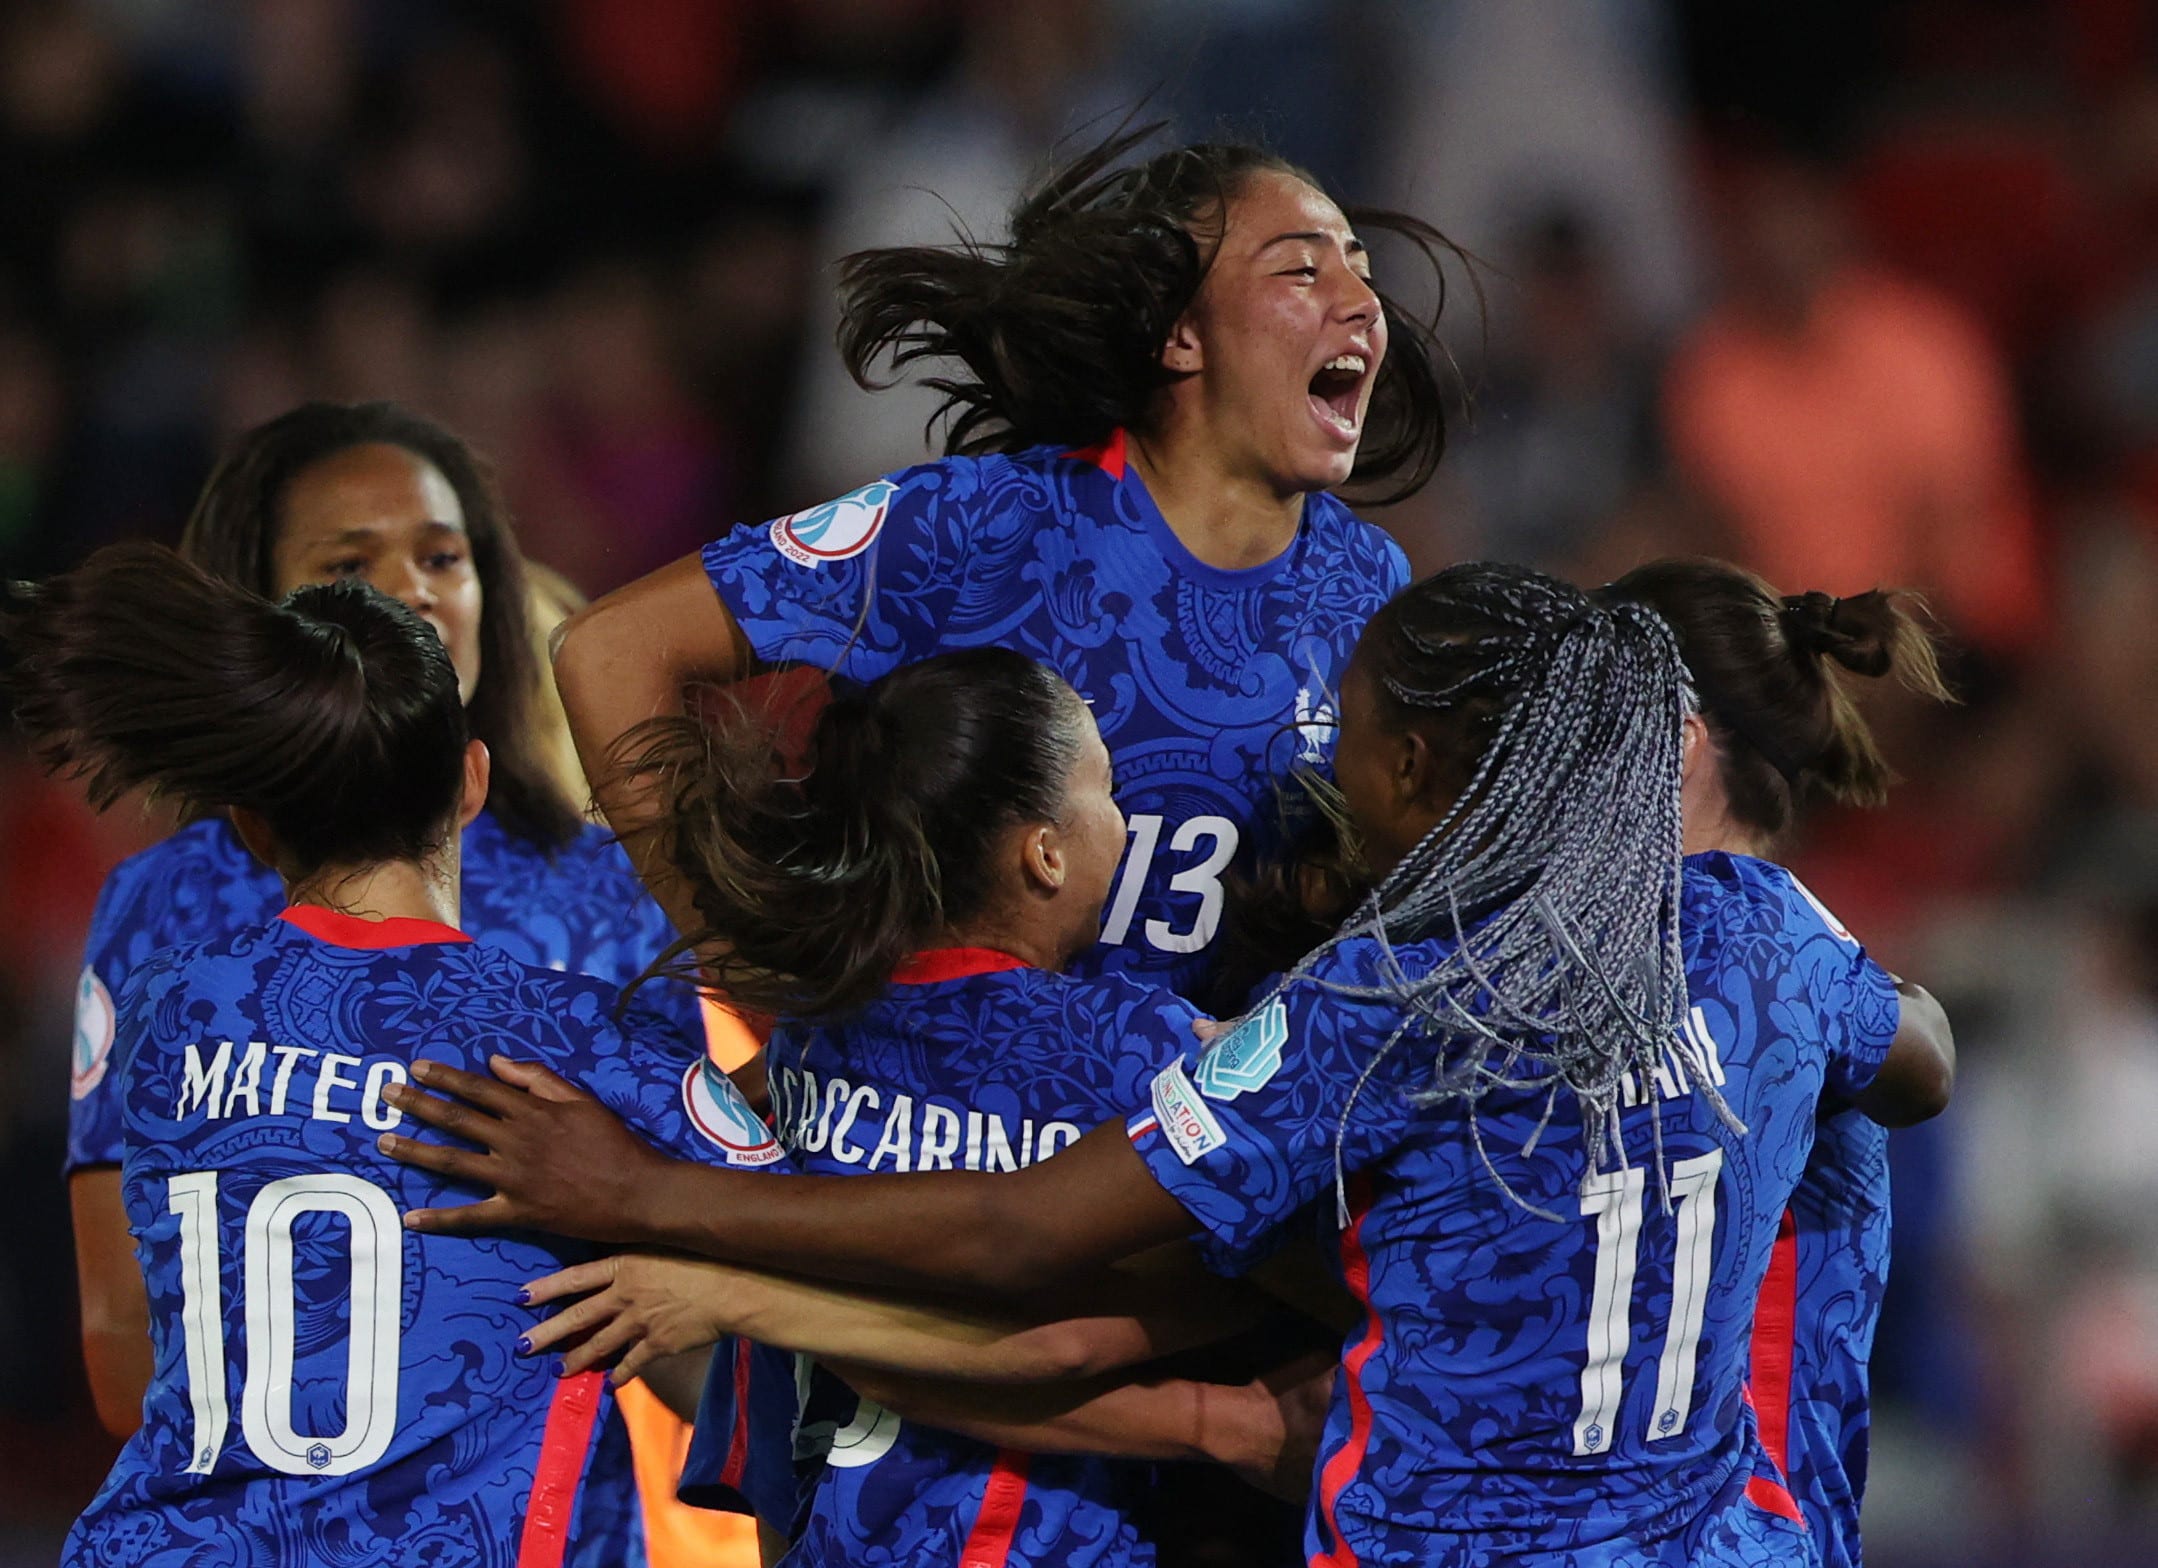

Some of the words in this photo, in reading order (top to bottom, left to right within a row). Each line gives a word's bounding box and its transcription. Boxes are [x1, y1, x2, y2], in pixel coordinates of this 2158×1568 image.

[785, 545, 811, 562] 2022
[1099, 814, 1239, 953] 13
[176, 1041, 408, 1131] MATEO
[735, 1146, 780, 1163] ENGLAND
[168, 1170, 402, 1476] 10
[1572, 1147, 1724, 1456] 11
